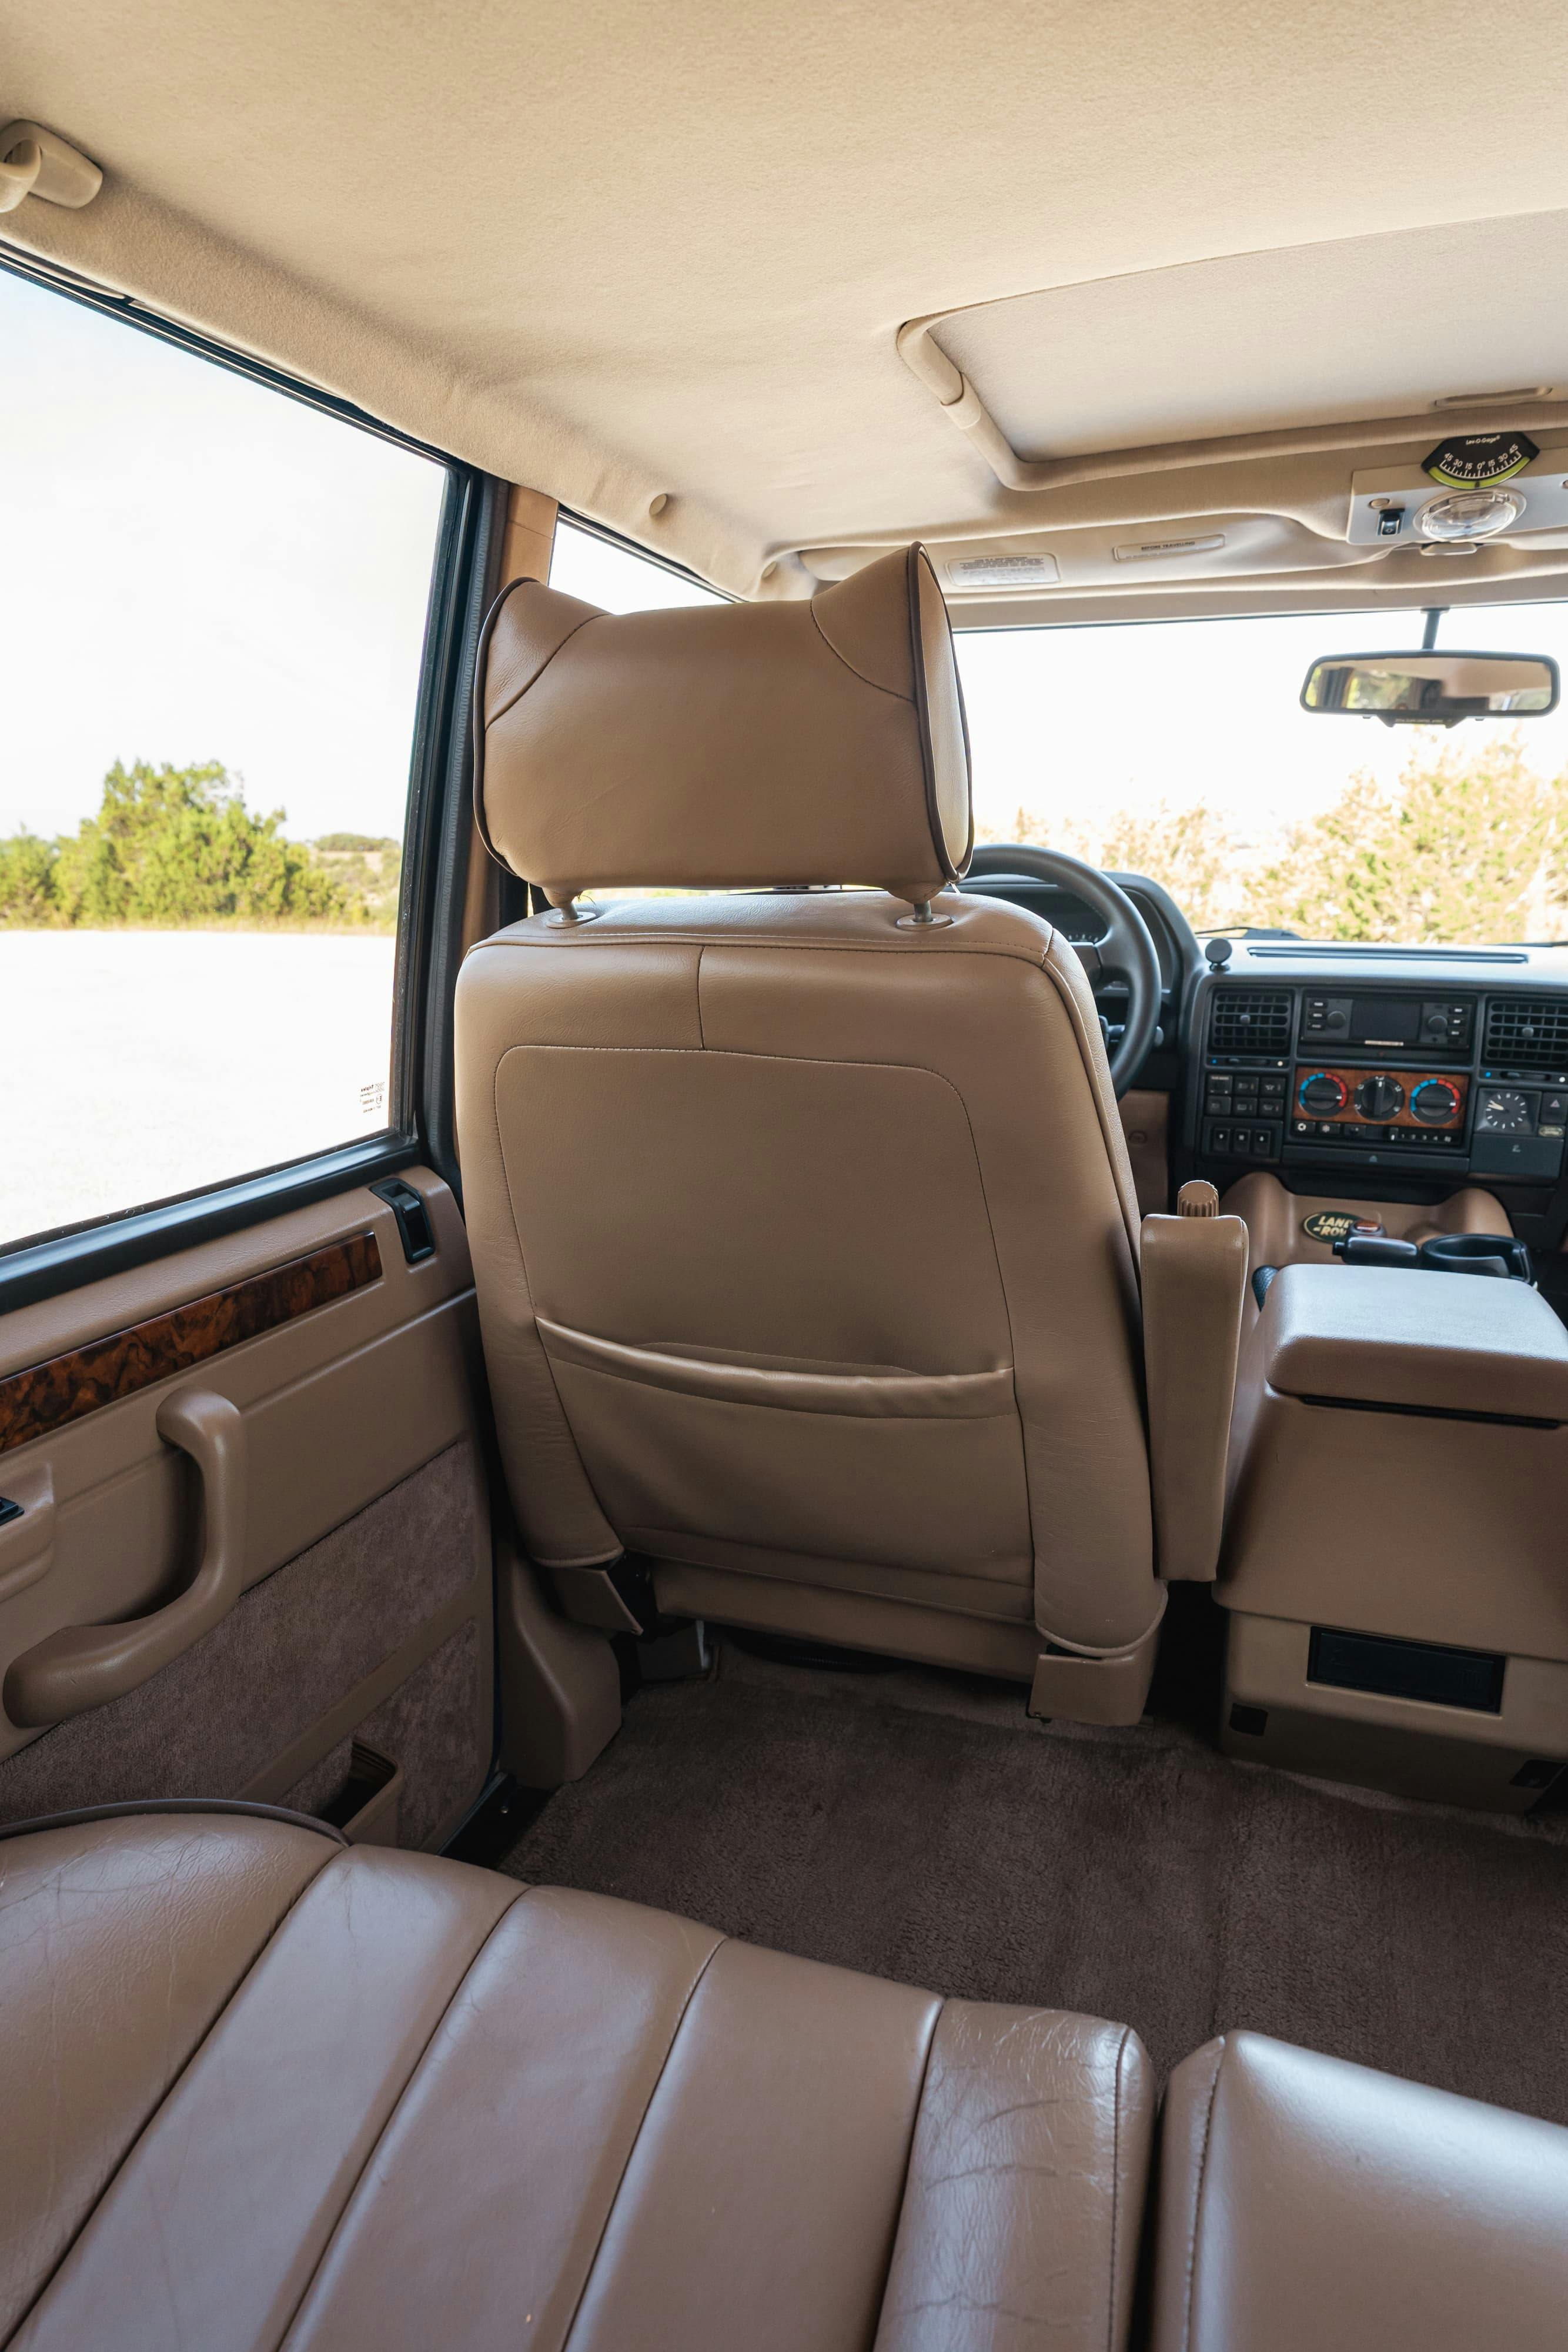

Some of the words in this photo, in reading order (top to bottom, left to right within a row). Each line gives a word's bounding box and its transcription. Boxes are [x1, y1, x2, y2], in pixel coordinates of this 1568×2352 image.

[1444, 453, 1454, 462] 45
[1453, 459, 1463, 467] 30
[1497, 453, 1508, 462] 30
[1509, 443, 1519, 454] 45
[1320, 1226, 1347, 1236] ROV
